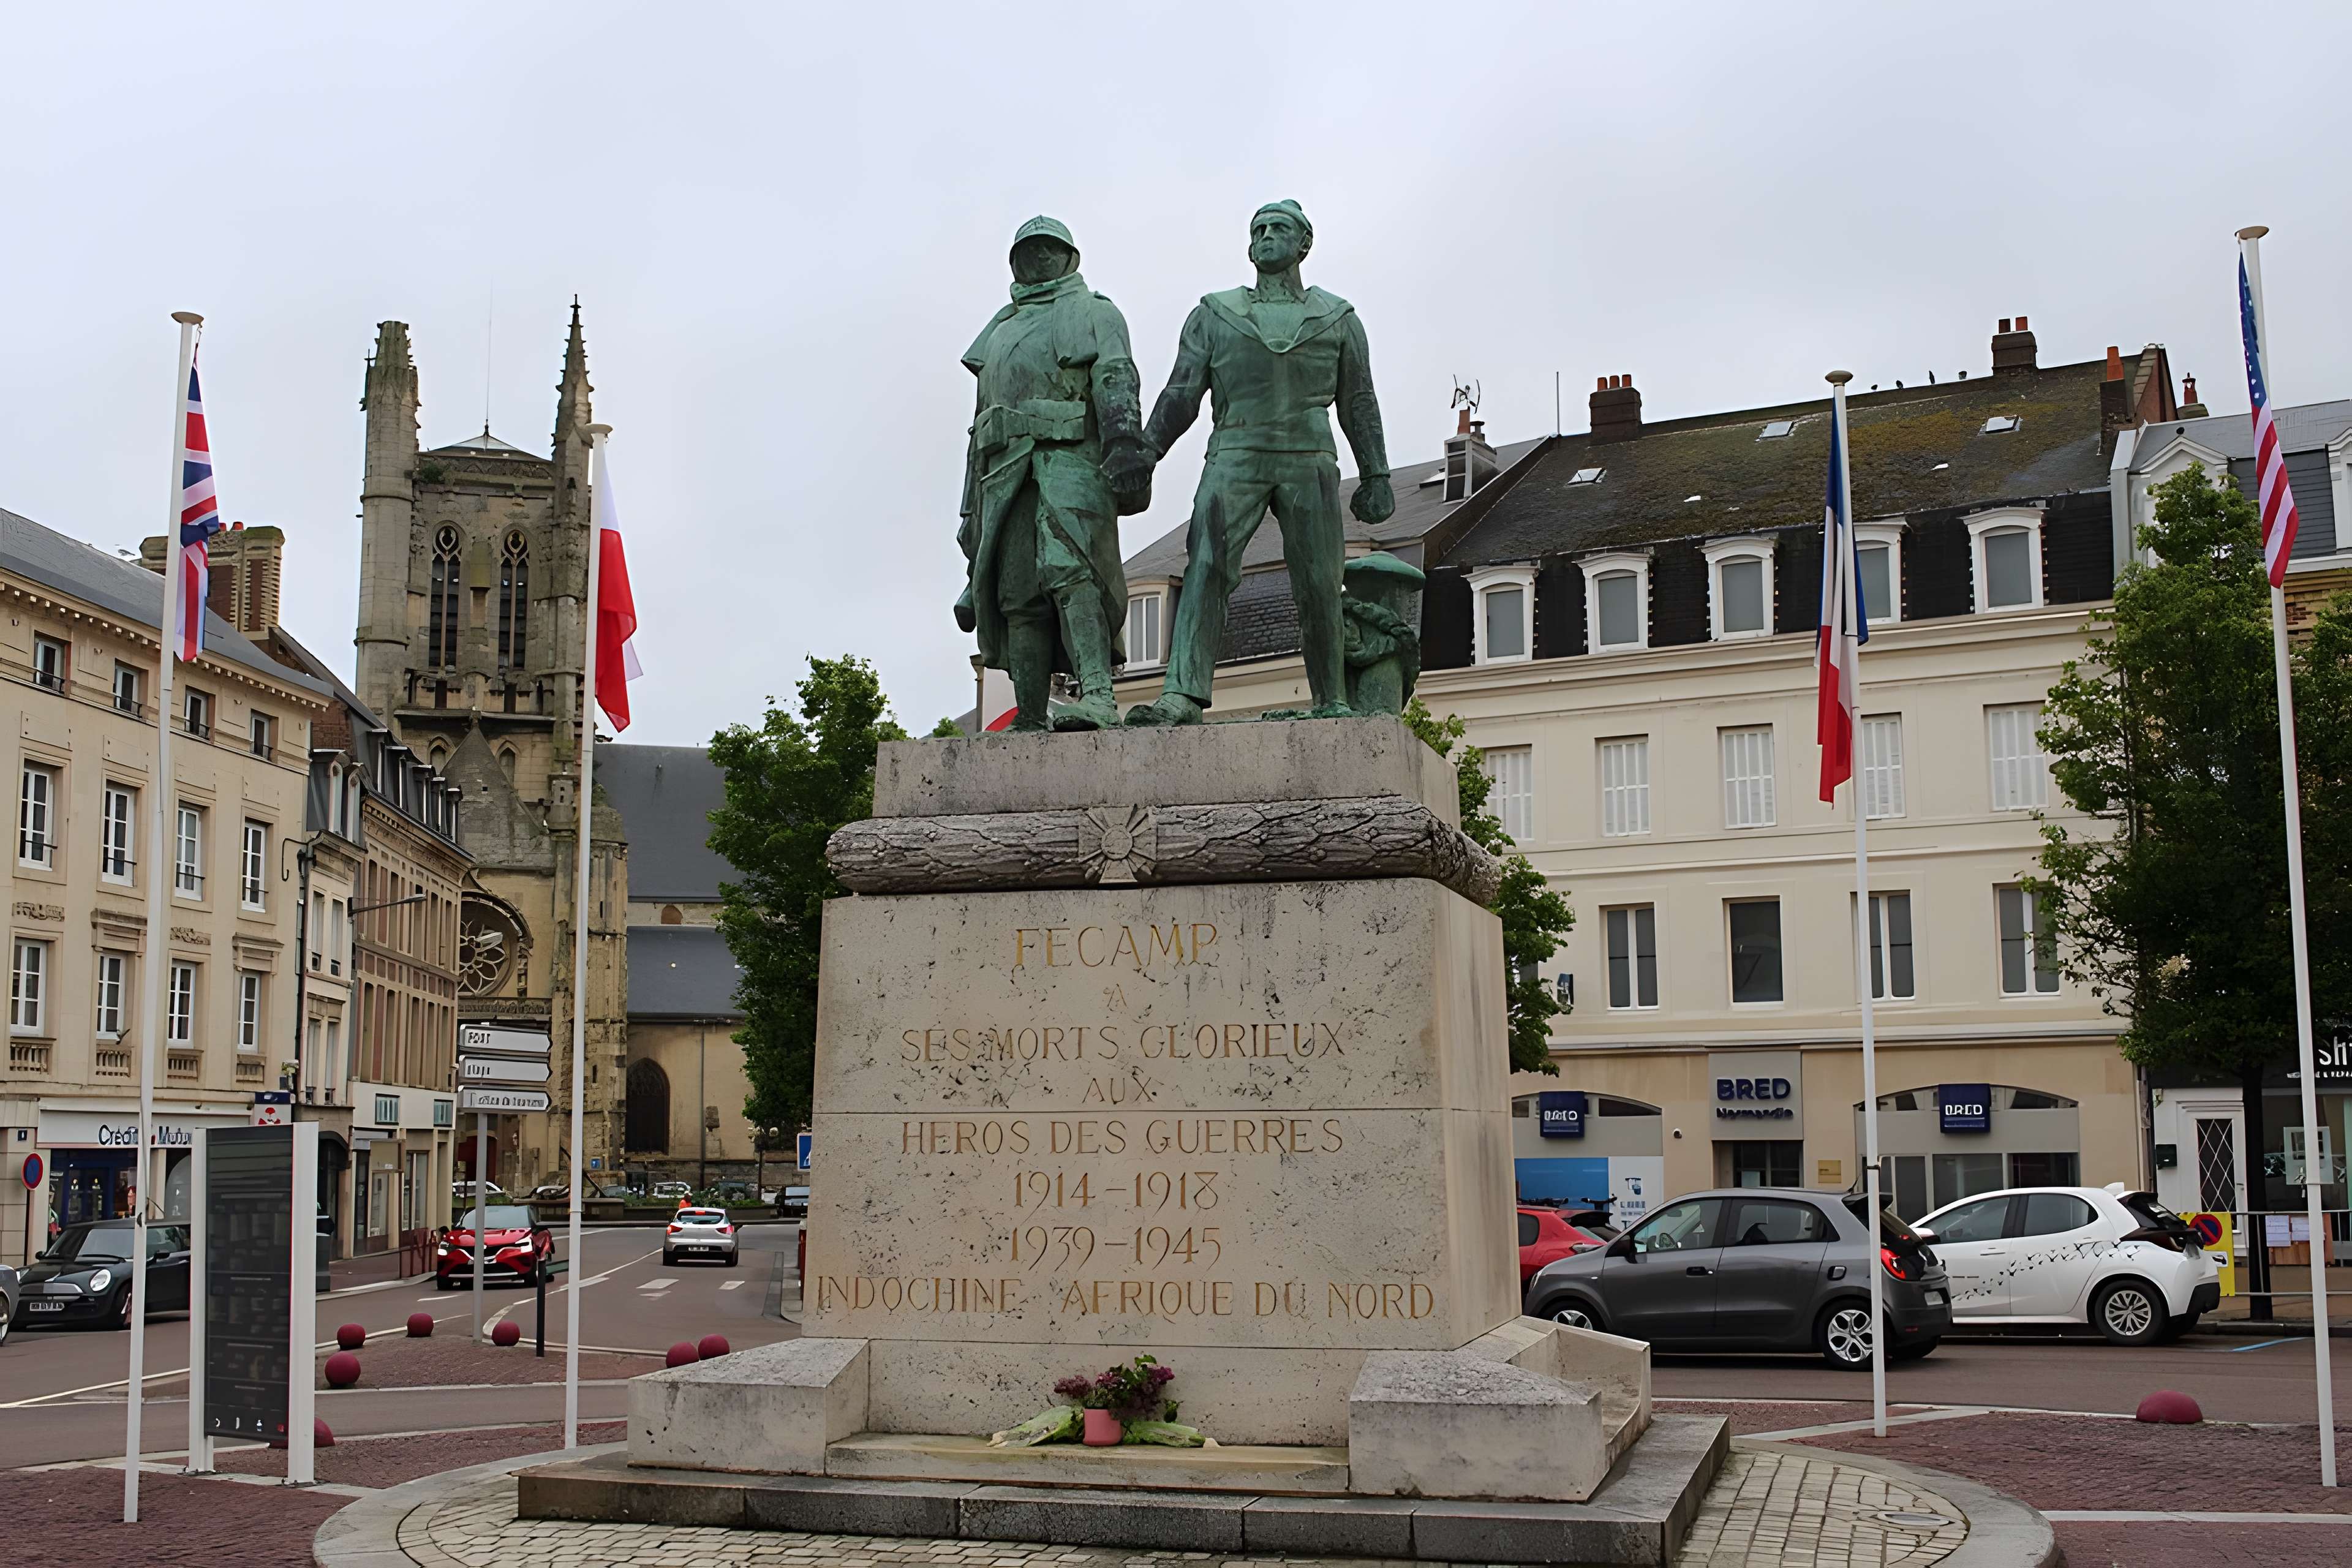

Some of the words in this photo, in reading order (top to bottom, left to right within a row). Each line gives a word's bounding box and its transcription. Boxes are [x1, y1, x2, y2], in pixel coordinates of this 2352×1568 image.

[1015, 923, 1218, 967] FECAMP
[902, 1028, 971, 1062] SES
[985, 1026, 1119, 1062] MORTS
[1140, 1022, 1346, 1059] GLORIEUX
[1082, 1077, 1154, 1104] AUX
[1716, 1078, 1792, 1101] BRED
[902, 1120, 1031, 1154] HEROS
[1049, 1120, 1126, 1154] DES
[1146, 1119, 1343, 1154] GUERRES
[817, 1276, 1025, 1315] INDOCHINE
[1060, 1280, 1234, 1324] AFRIQUE
[1254, 1281, 1306, 1318] DU
[1328, 1282, 1434, 1319] NORD
